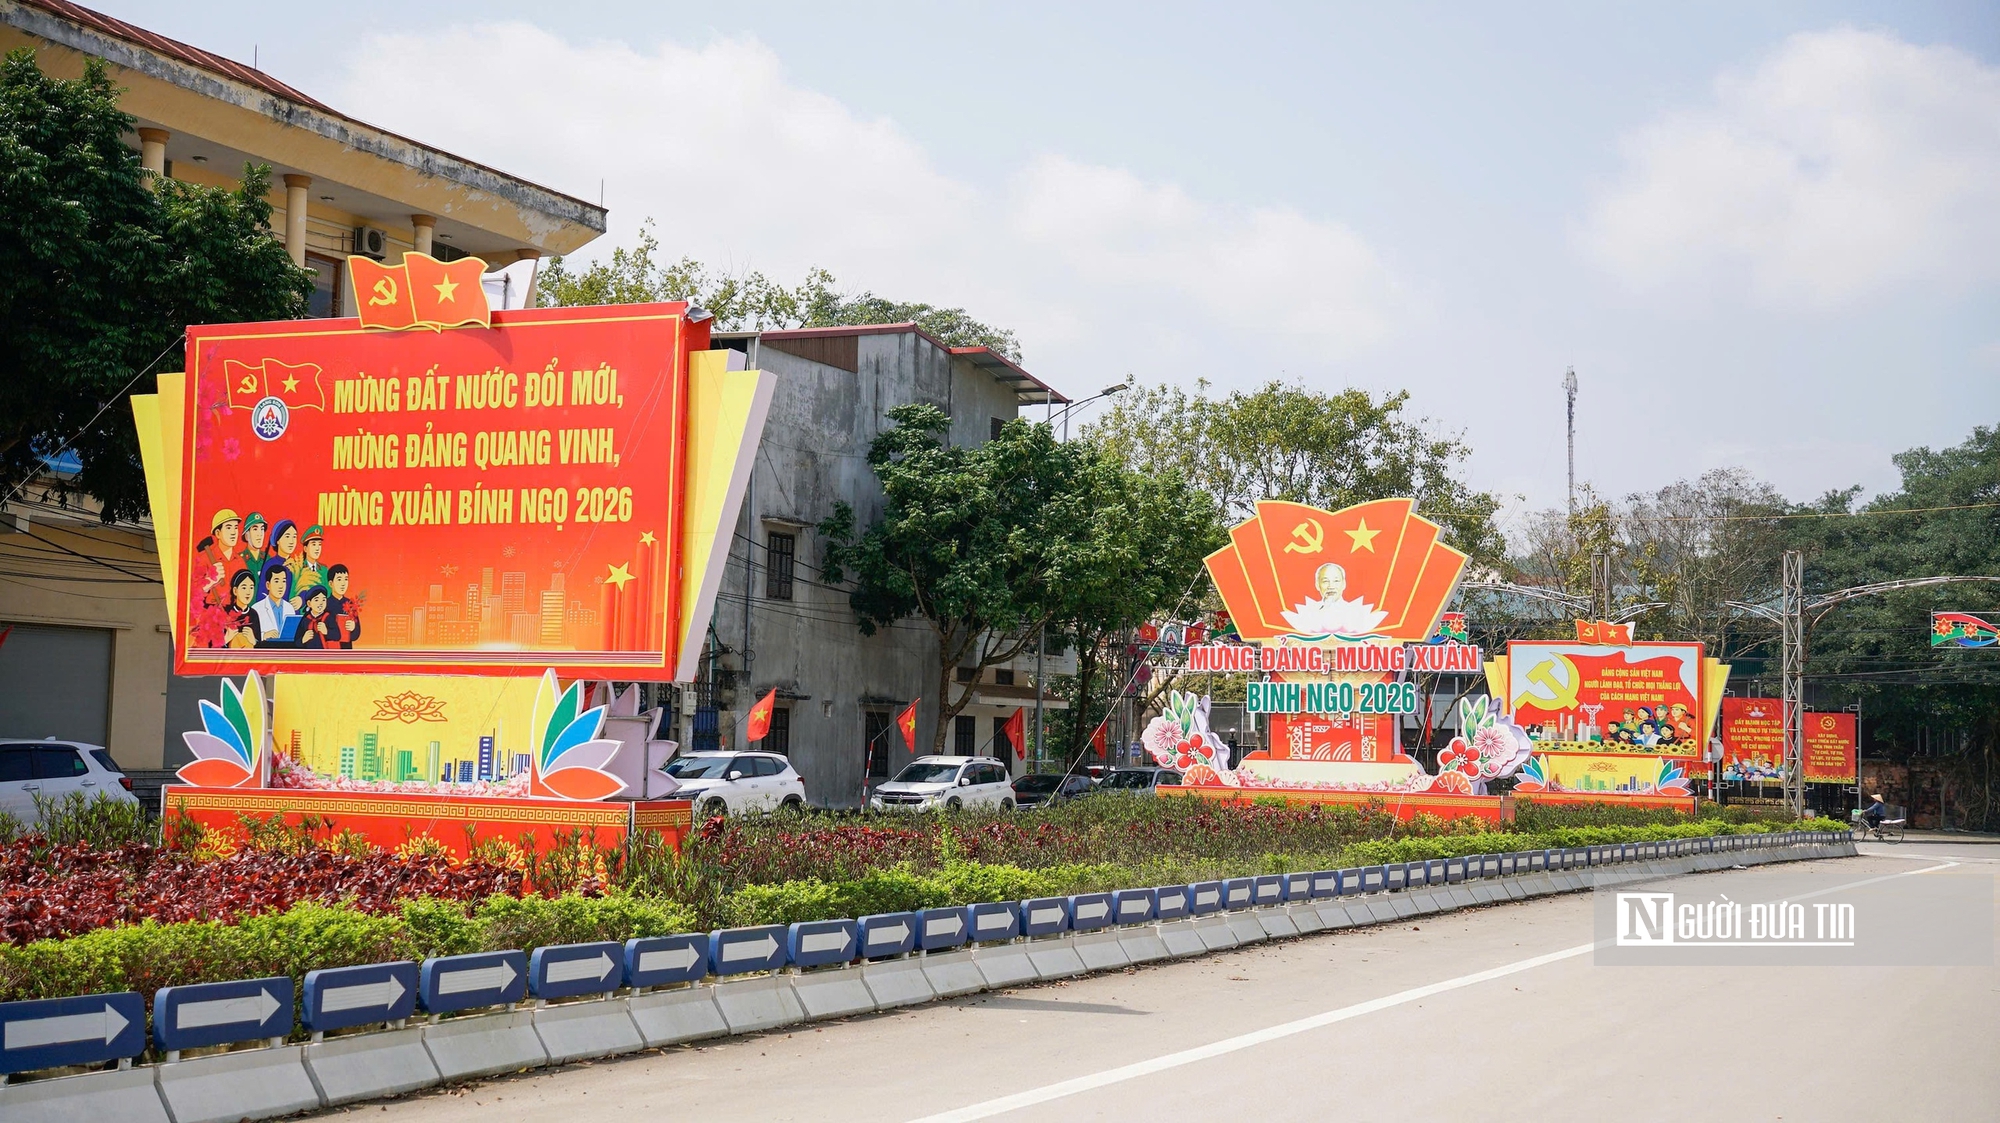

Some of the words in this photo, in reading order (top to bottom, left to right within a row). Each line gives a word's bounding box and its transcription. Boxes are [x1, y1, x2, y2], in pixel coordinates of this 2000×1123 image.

[334, 372, 400, 413] MỪNG
[406, 364, 450, 411] ĐẤT
[456, 366, 518, 409] NƯỚC
[525, 357, 564, 407] ĐỔI
[571, 362, 624, 408] MỚI,
[333, 428, 399, 469] MỪNG
[405, 422, 467, 467] ĐẢNG
[475, 430, 550, 470] QUANG
[559, 428, 620, 467] VINH,
[318, 485, 383, 526] MỪNG
[390, 483, 451, 525] XUÂN
[458, 482, 513, 524] BÍNH
[520, 487, 568, 531] NGỌ
[575, 487, 632, 523] 2026
[1189, 640, 1253, 670] MỪNG
[1261, 637, 1330, 672] ĐẢNG,
[1336, 641, 1405, 671] MỪNG
[1413, 641, 1478, 671] XUÂN
[1601, 667, 1615, 677] ĐẢNG
[1615, 667, 1629, 678] CỘNG
[1629, 667, 1640, 677] SẢN
[1640, 667, 1651, 679] VIỆT
[1651, 669, 1663, 678] NAM
[1247, 677, 1300, 713] BÍNH
[1306, 683, 1355, 719] NGỌ
[1359, 683, 1416, 713] 2026
[1584, 679, 1599, 688] NGƯỜI
[1625, 679, 1631, 689] TỔ
[1632, 680, 1645, 689] CHỨC
[1645, 681, 1655, 690] MỌI
[1656, 680, 1672, 690] THẮNG
[1673, 681, 1681, 691] LỢI
[1600, 691, 1609, 700] CỦA
[1610, 691, 1624, 700] CÁCH
[1624, 692, 1639, 702] MẠNG
[1640, 692, 1650, 702] VIỆT
